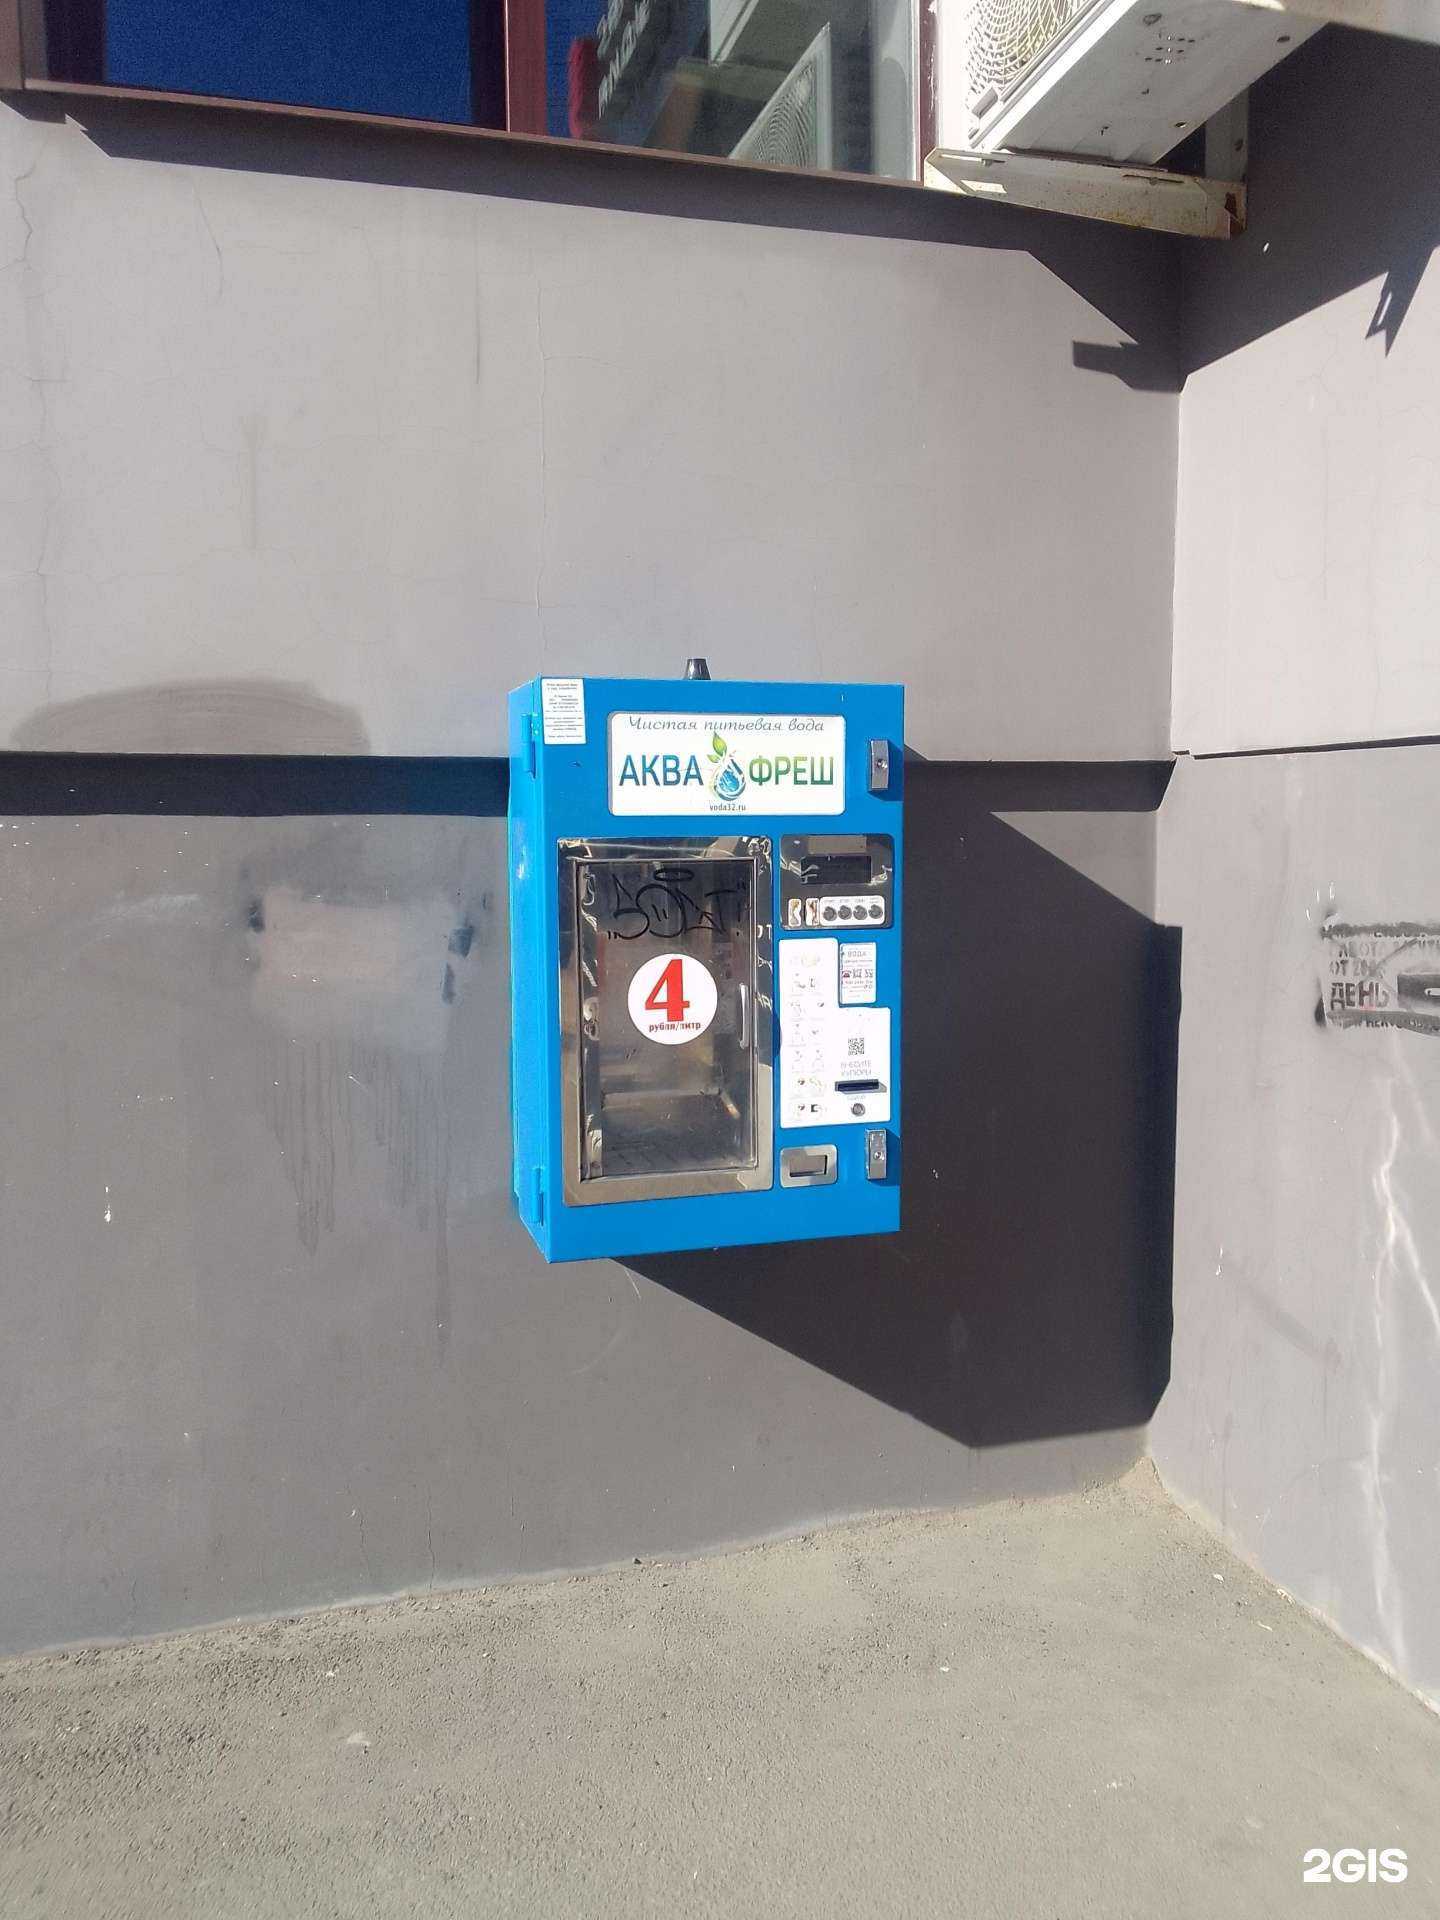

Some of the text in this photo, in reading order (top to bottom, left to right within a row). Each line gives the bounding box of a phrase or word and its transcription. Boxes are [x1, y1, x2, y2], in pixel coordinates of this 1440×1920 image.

[629, 716, 825, 732] Чистая питьевая вода
[619, 754, 834, 786] АКВА ФРЕШ
[709, 803, 747, 812] voda32.ru
[645, 958, 690, 1022] 4
[1330, 980, 1390, 1010] ДЕНЬ
[649, 1021, 701, 1033] рубля/литр
